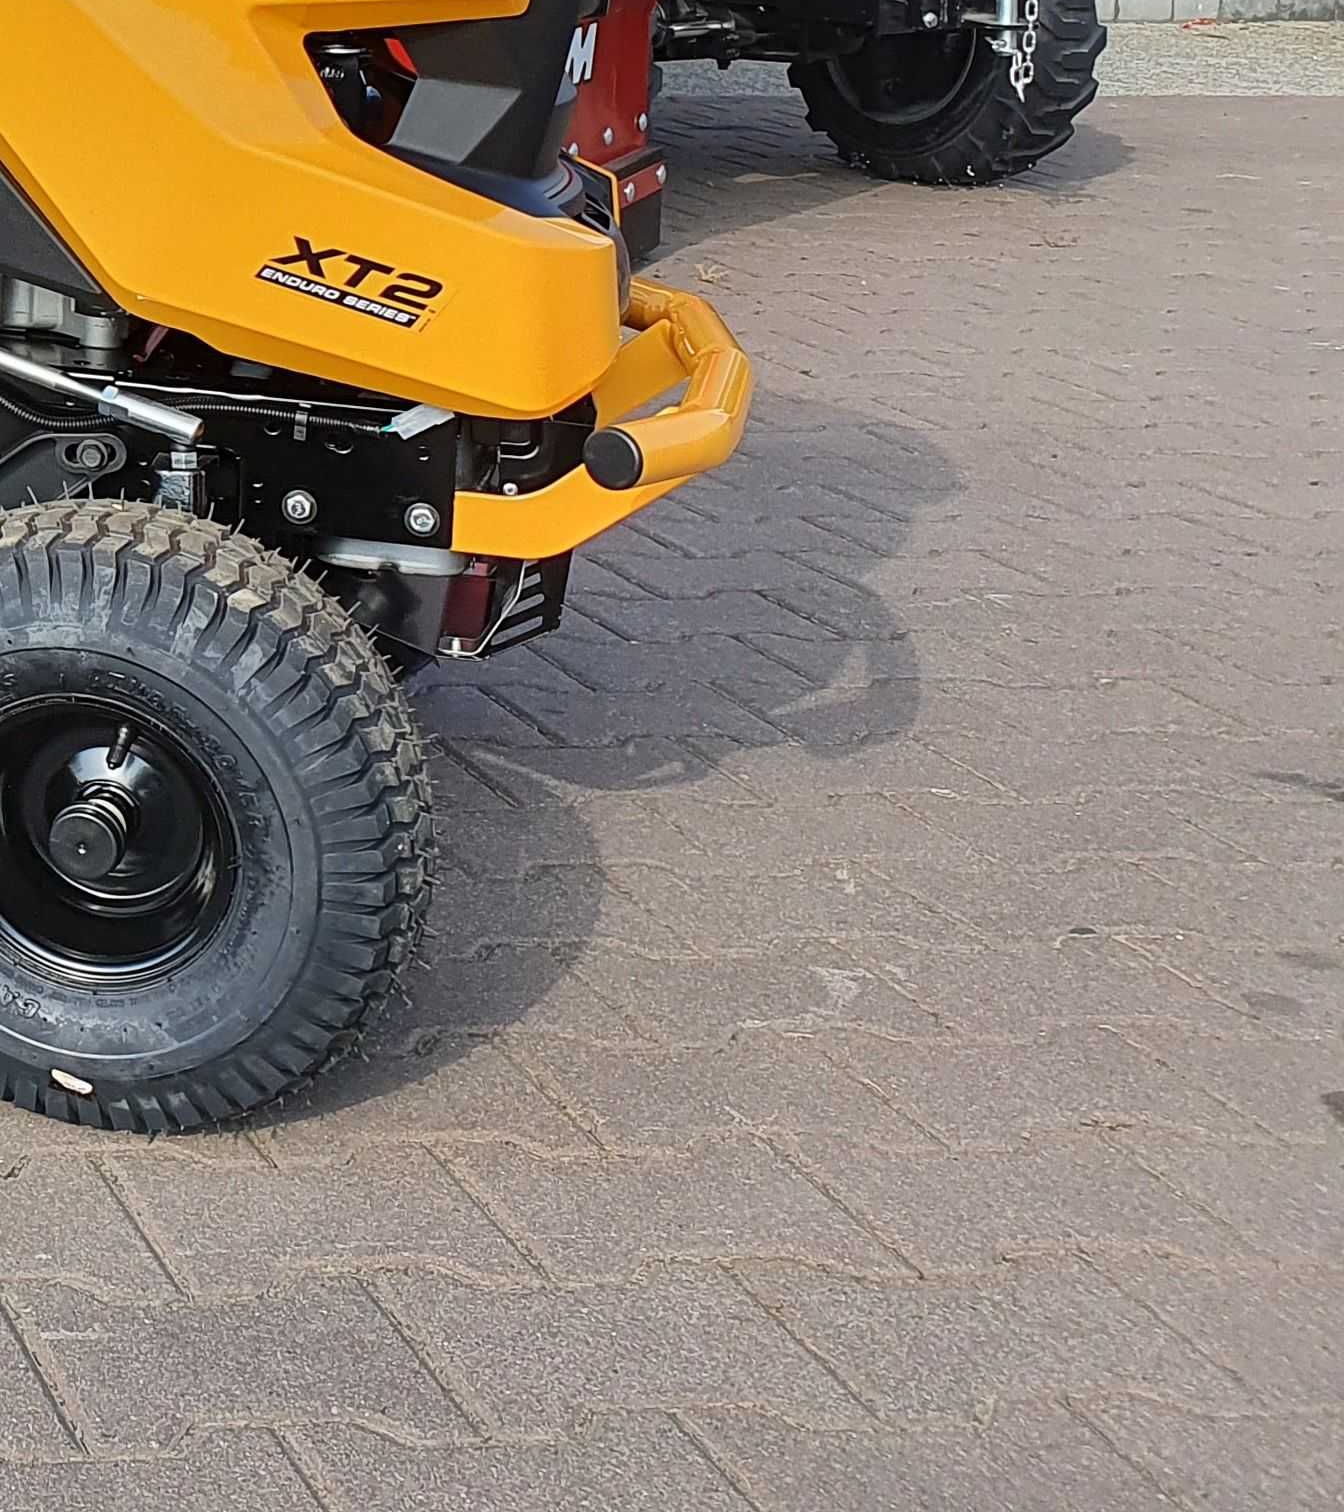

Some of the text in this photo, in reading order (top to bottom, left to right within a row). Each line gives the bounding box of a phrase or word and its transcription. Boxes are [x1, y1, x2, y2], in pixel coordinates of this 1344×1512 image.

[259, 267, 417, 325] ENDURO SERIES
[268, 235, 444, 311] XT2
